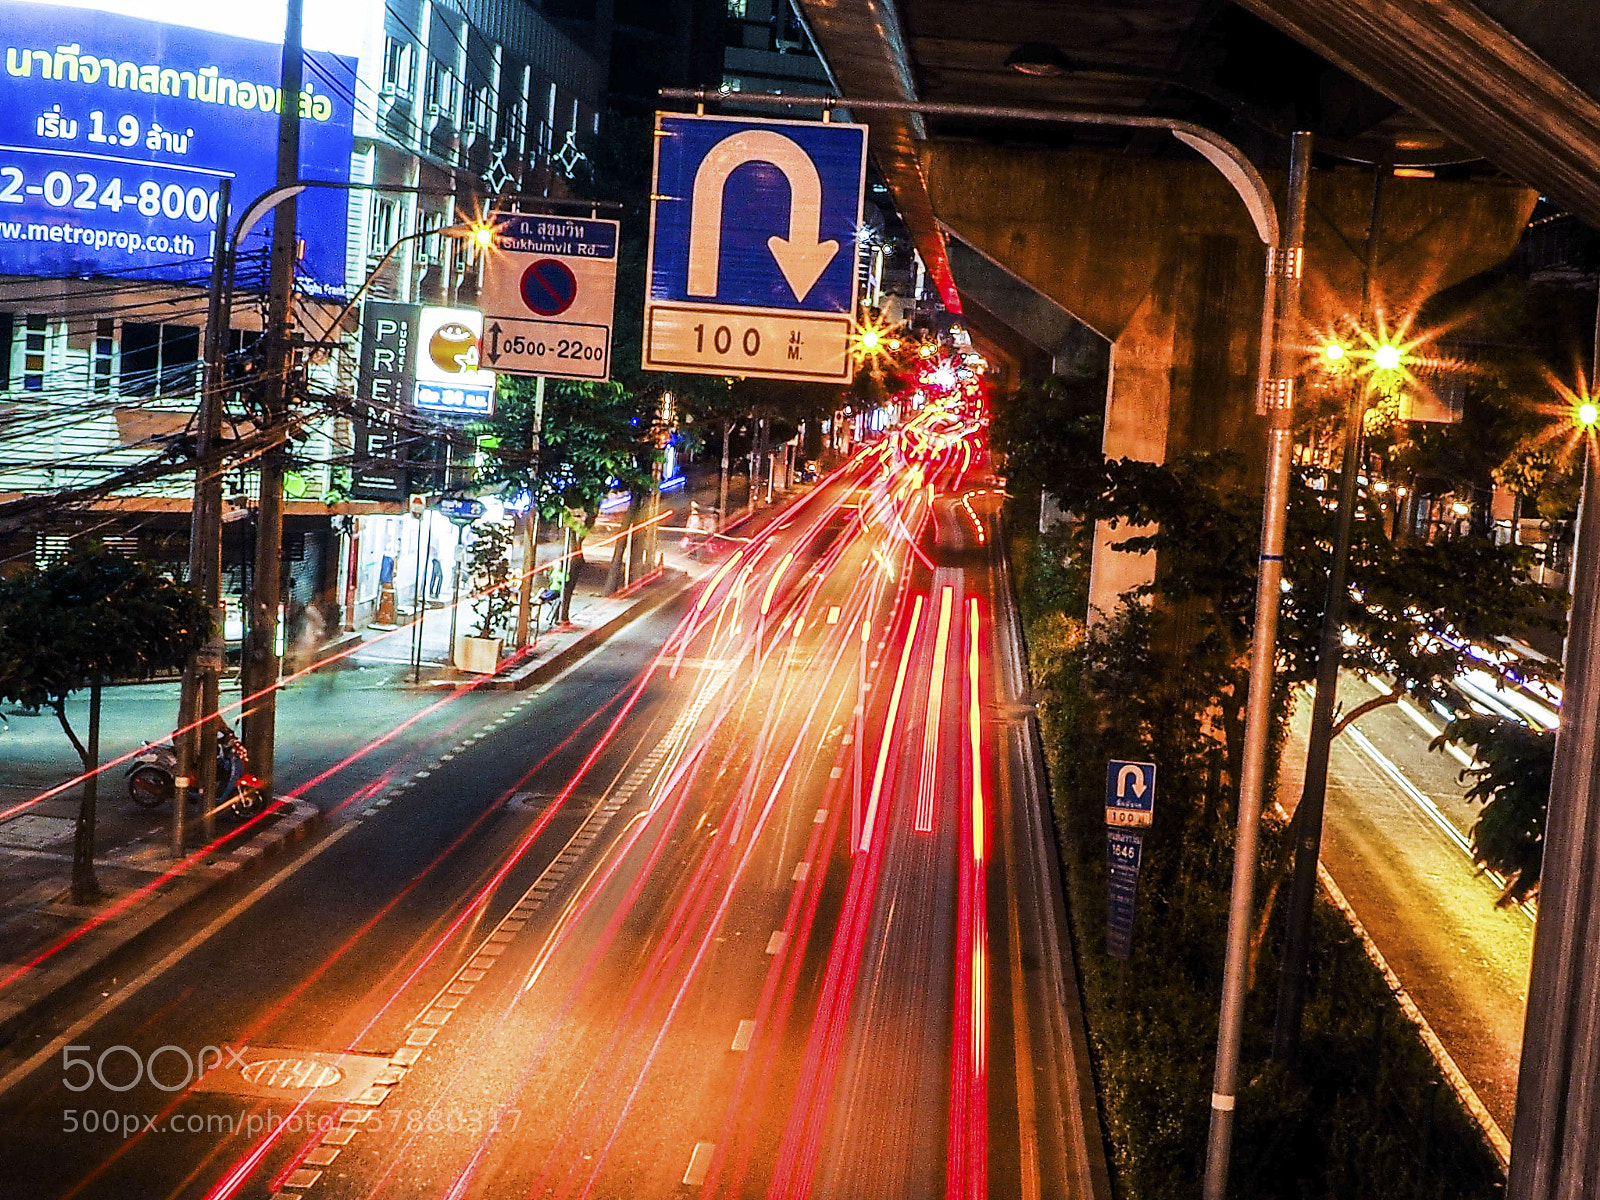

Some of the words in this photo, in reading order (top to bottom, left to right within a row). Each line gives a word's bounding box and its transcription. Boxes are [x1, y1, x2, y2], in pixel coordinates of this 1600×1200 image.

[36, 103, 78, 140] เริ่ม
[88, 110, 140, 147] 1.9
[0, 221, 195, 255] w.metroprop.co.th
[537, 220, 585, 241] สุขุมวิท
[577, 243, 599, 256] Rd.
[693, 324, 761, 357] 100
[788, 345, 803, 361] M.
[1112, 812, 1134, 823] 100
